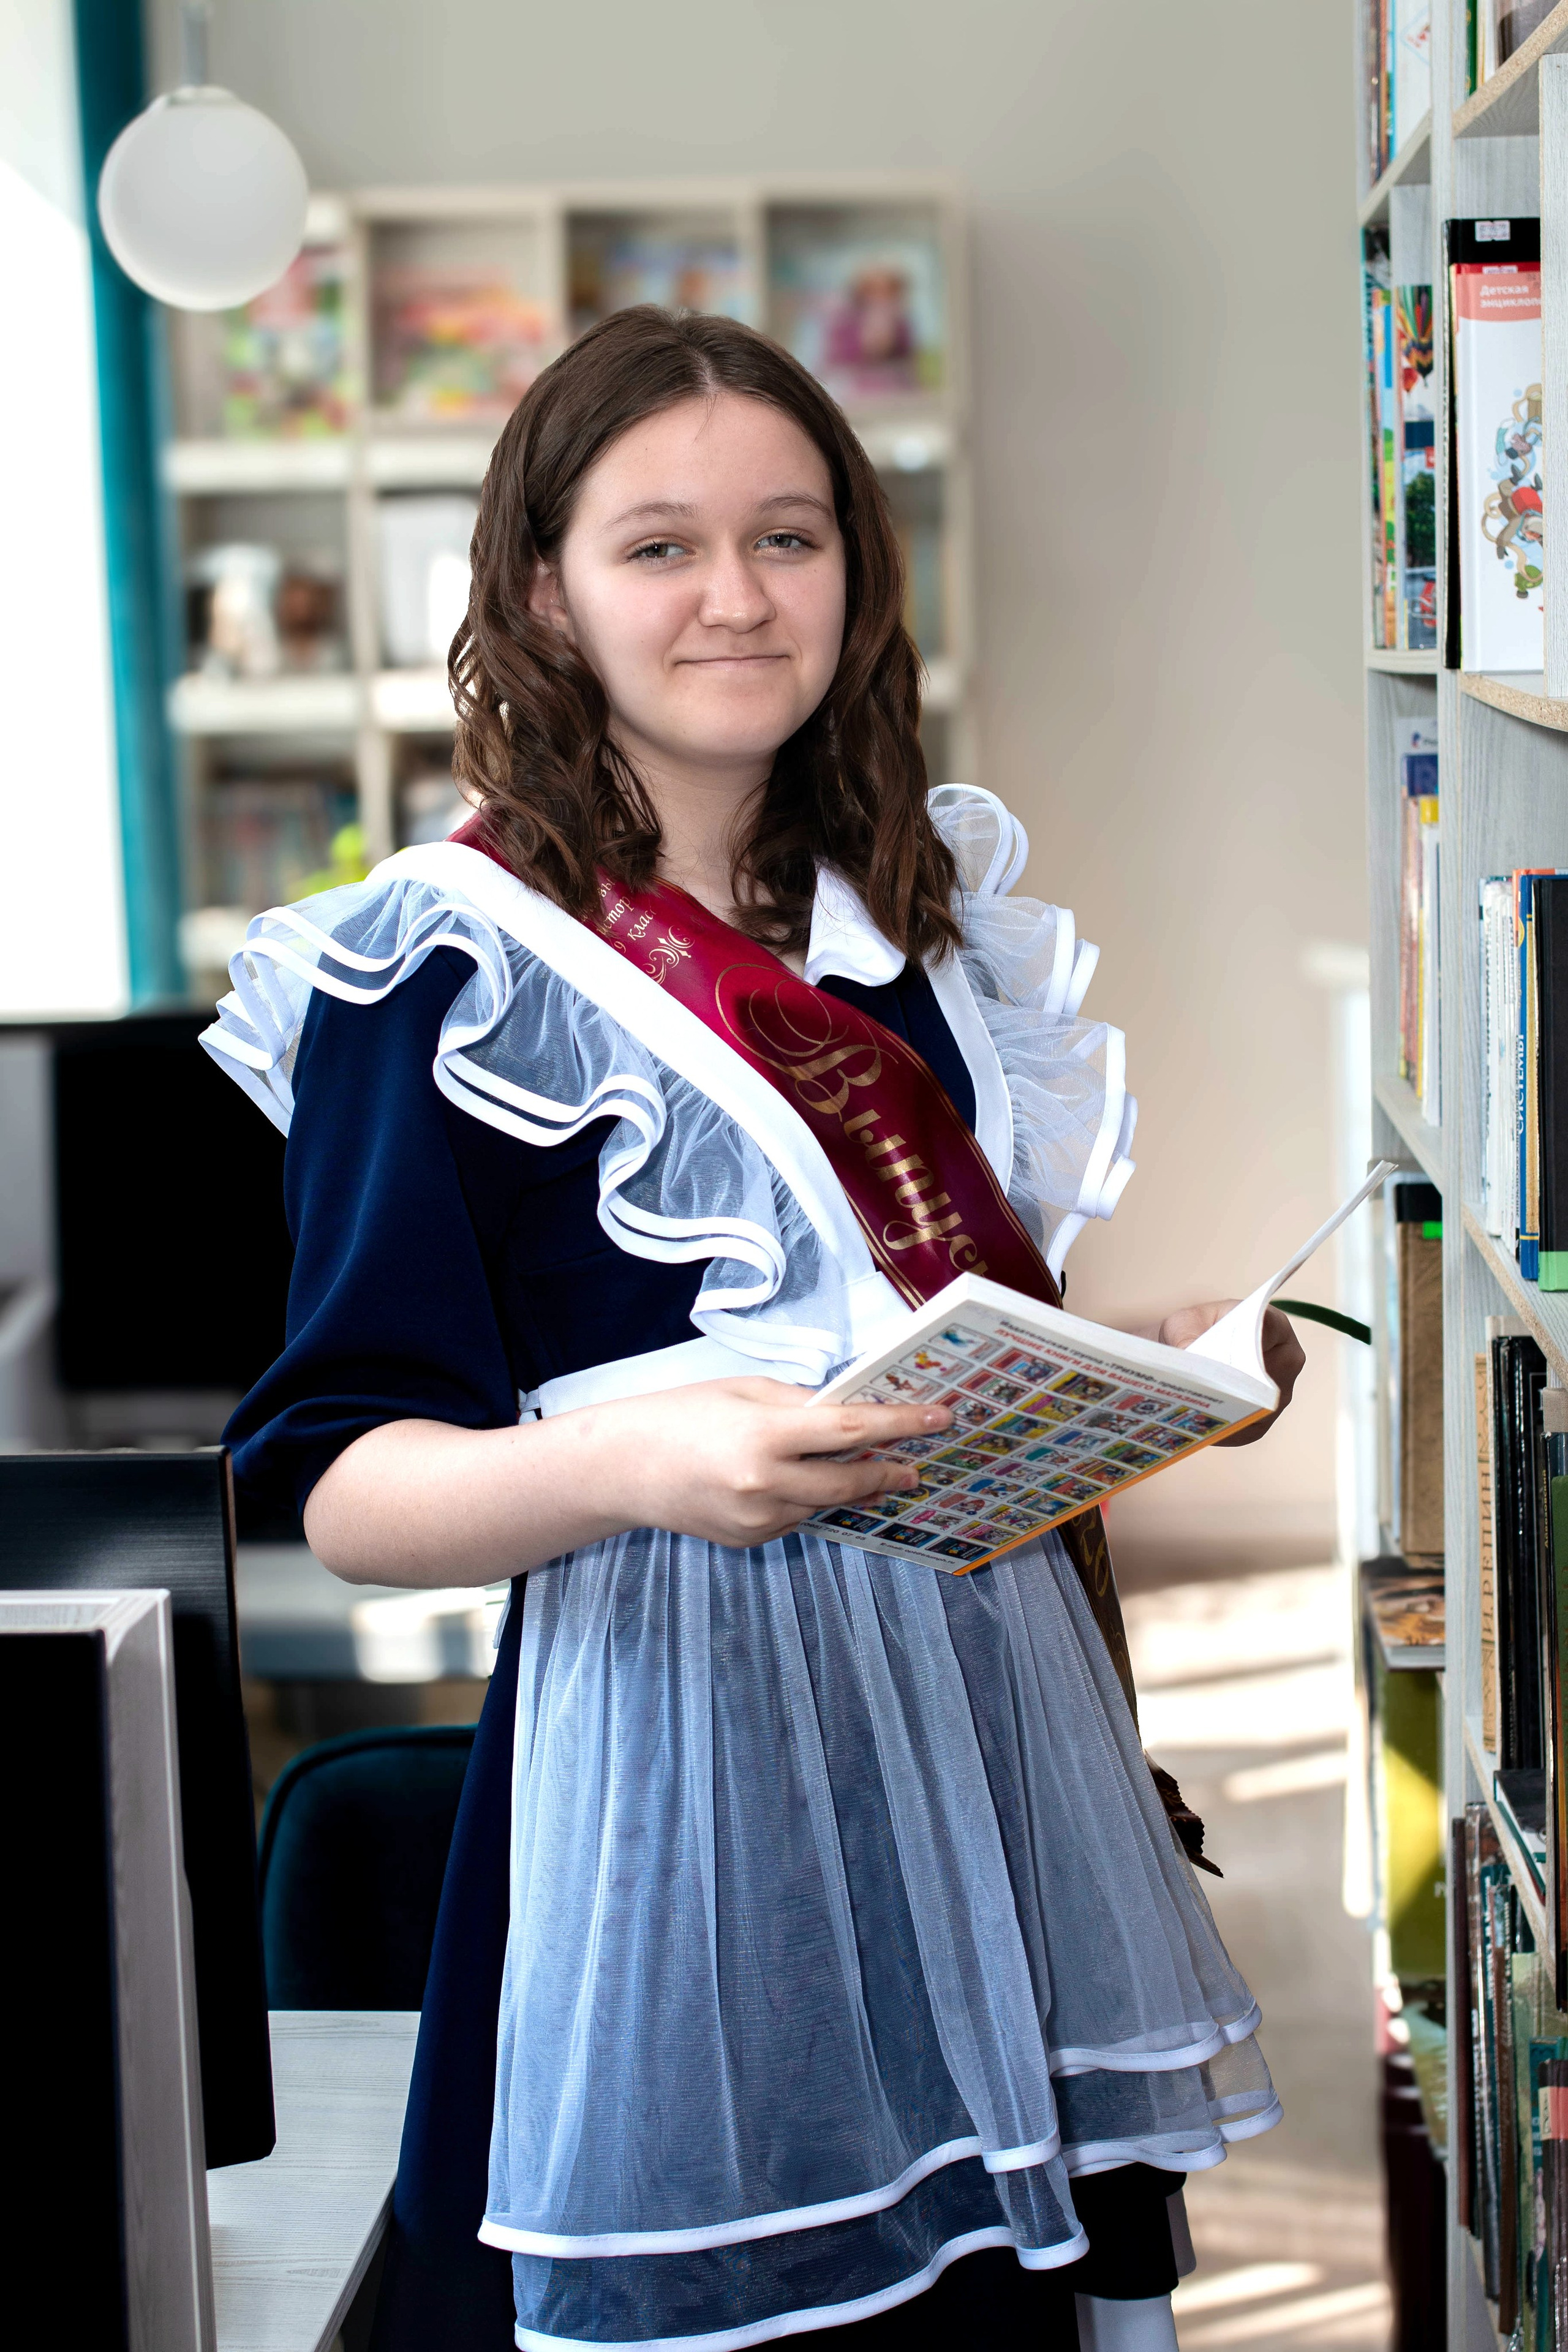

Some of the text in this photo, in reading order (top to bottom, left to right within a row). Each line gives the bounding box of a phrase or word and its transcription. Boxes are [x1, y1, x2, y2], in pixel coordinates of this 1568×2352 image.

[1480, 285, 1528, 296] Детская
[614, 940, 627, 954] 9
[995, 1329, 1212, 1409] ЛУЧШИЕ КНИГИ ДЛЯ ВАШЕГО МАГАЗИНА
[1481, 1471, 1494, 1596] РЕПИН
